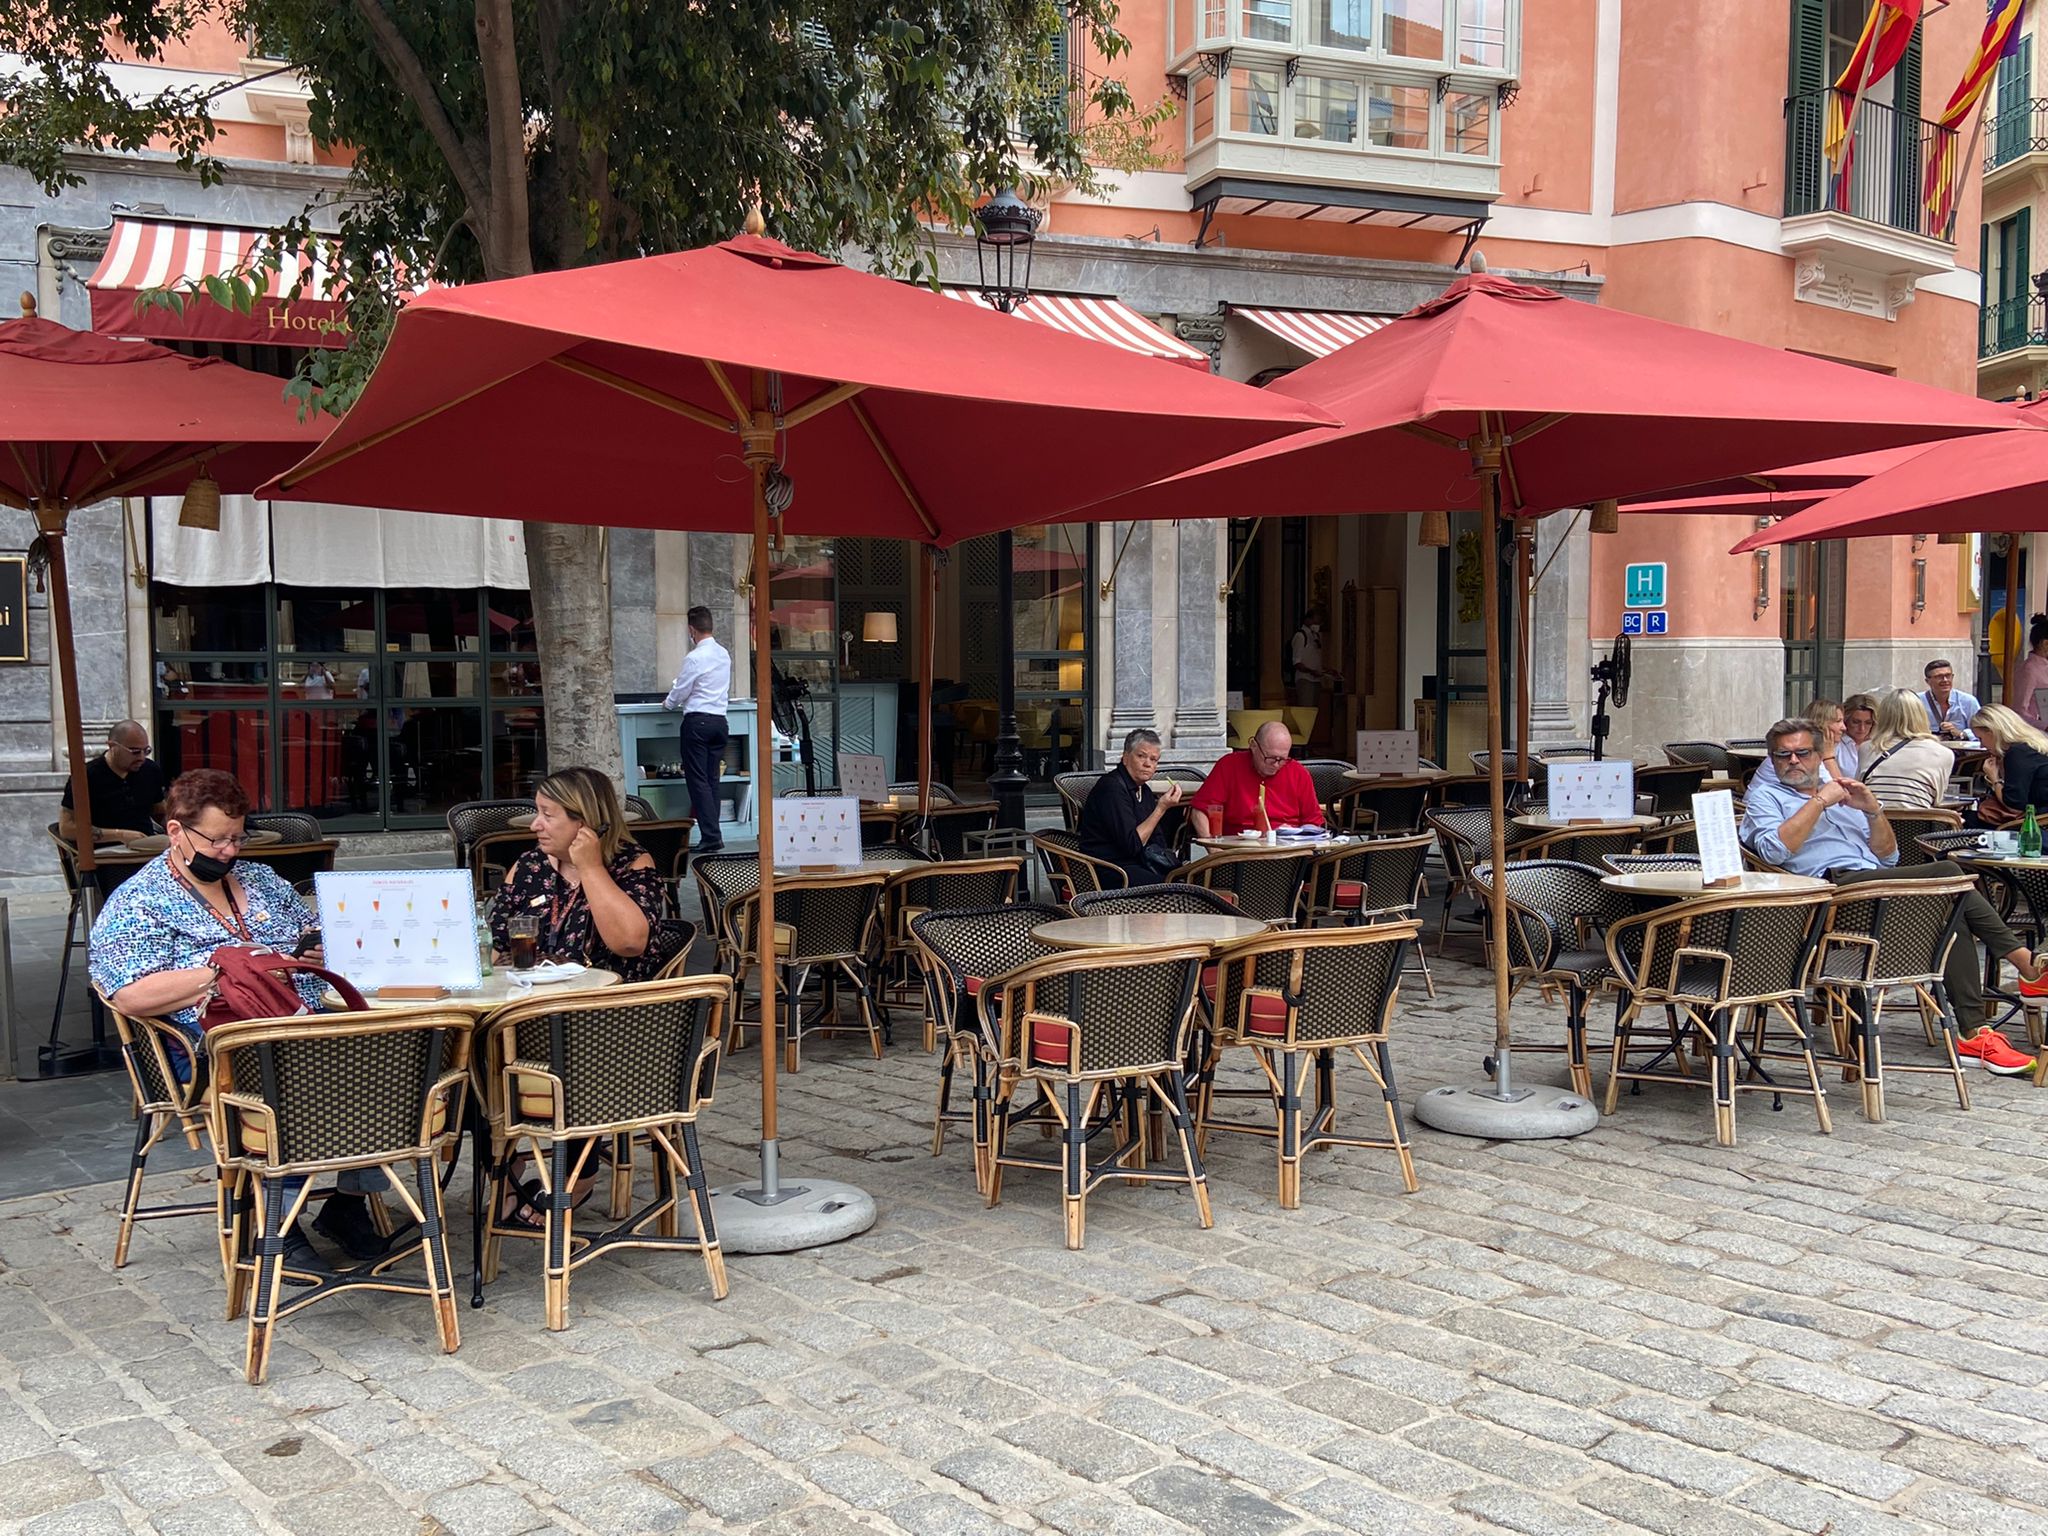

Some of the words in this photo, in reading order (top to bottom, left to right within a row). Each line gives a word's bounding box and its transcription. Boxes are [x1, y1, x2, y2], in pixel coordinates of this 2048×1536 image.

[268, 306, 336, 332] Hotel
[1637, 569, 1653, 591] H
[1624, 615, 1640, 628] BC
[1651, 615, 1660, 628] R
